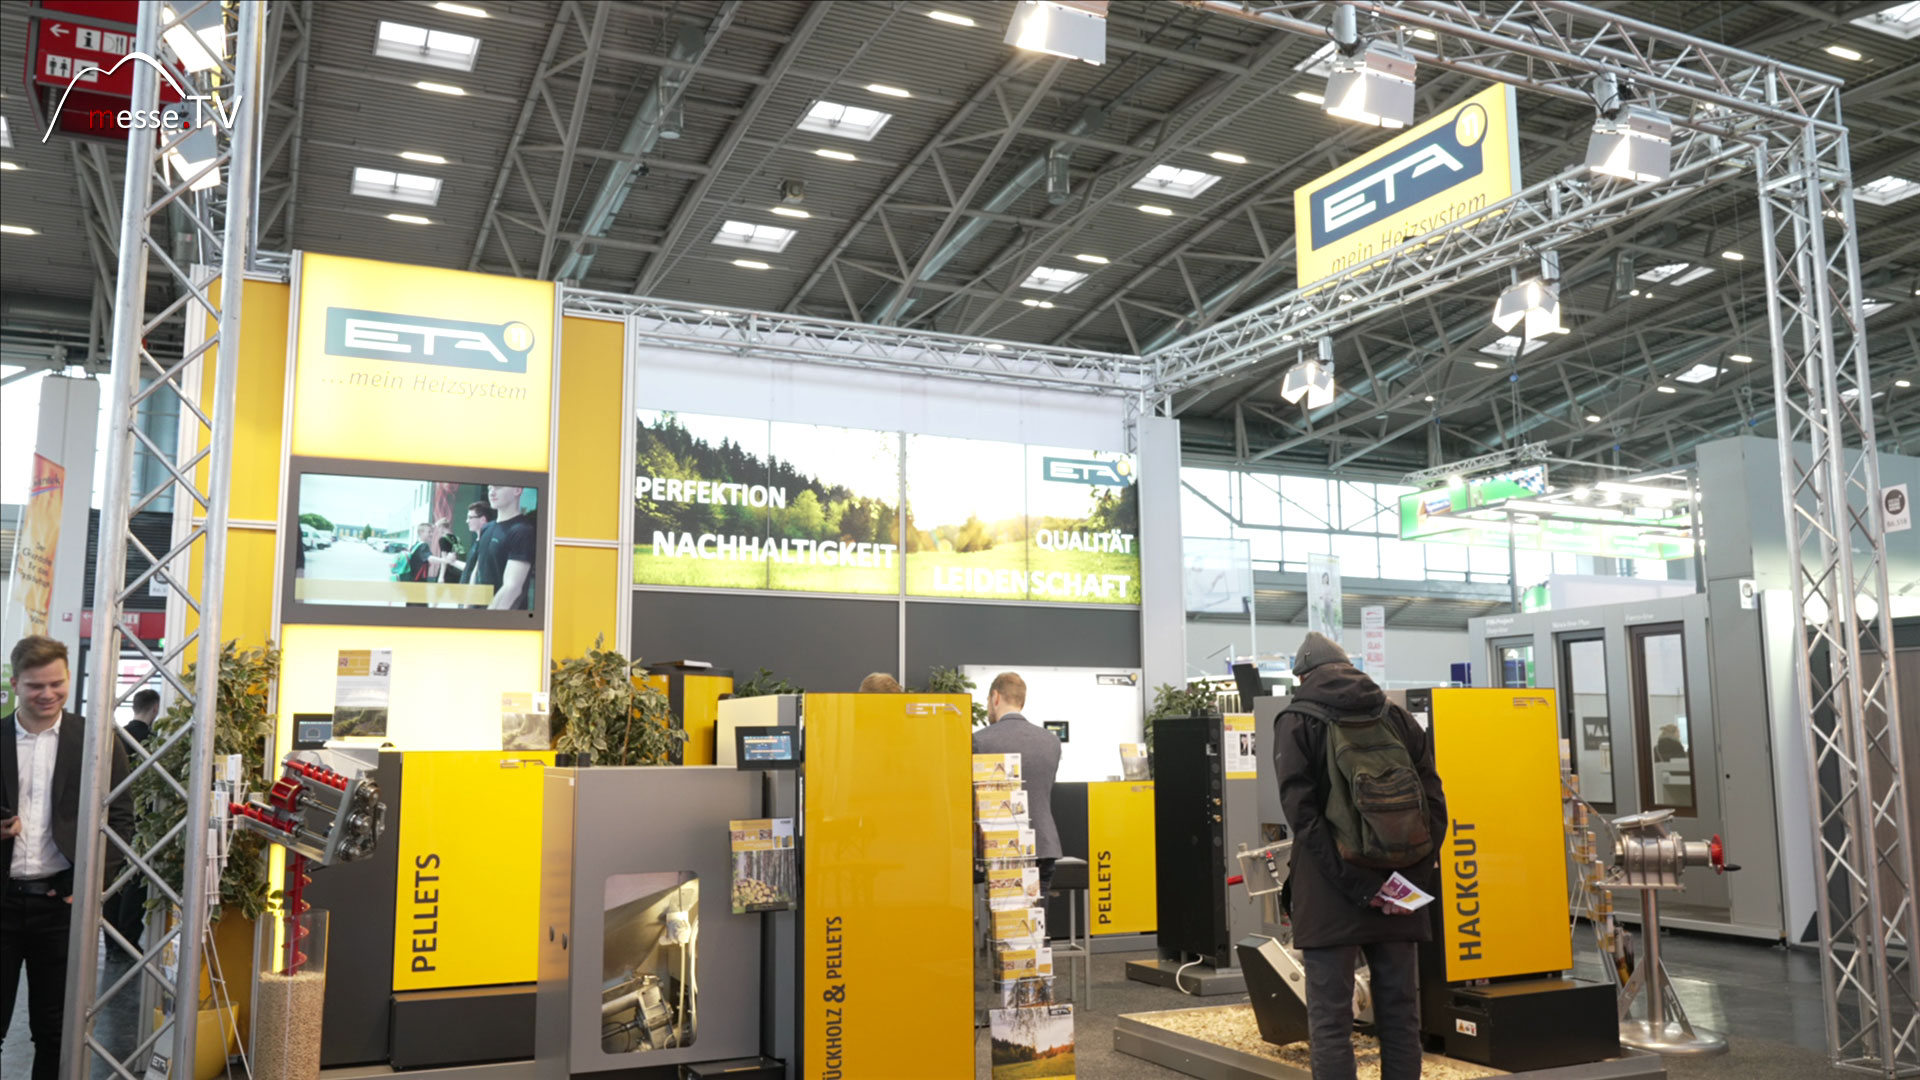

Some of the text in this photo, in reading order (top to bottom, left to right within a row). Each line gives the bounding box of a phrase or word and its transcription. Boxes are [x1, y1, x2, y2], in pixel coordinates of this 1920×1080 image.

[1323, 142, 1464, 233] ETA
[344, 317, 509, 364] ETA
[412, 373, 528, 401] Heizsystem
[1050, 461, 1121, 482] ETA
[635, 476, 787, 510] PERFEKTION
[652, 530, 898, 569] NACHHALTIGKEIT
[1036, 529, 1134, 554] QUALITÄT
[933, 565, 1131, 599] LEIDENSCHAFT
[905, 703, 963, 716] ETA
[1512, 697, 1550, 708] ETA
[1097, 850, 1112, 925] PELLETS
[1452, 818, 1482, 961] HACKGUT
[411, 853, 441, 973] PELLETS
[825, 916, 843, 980] PELLETS
[823, 983, 846, 1003] &
